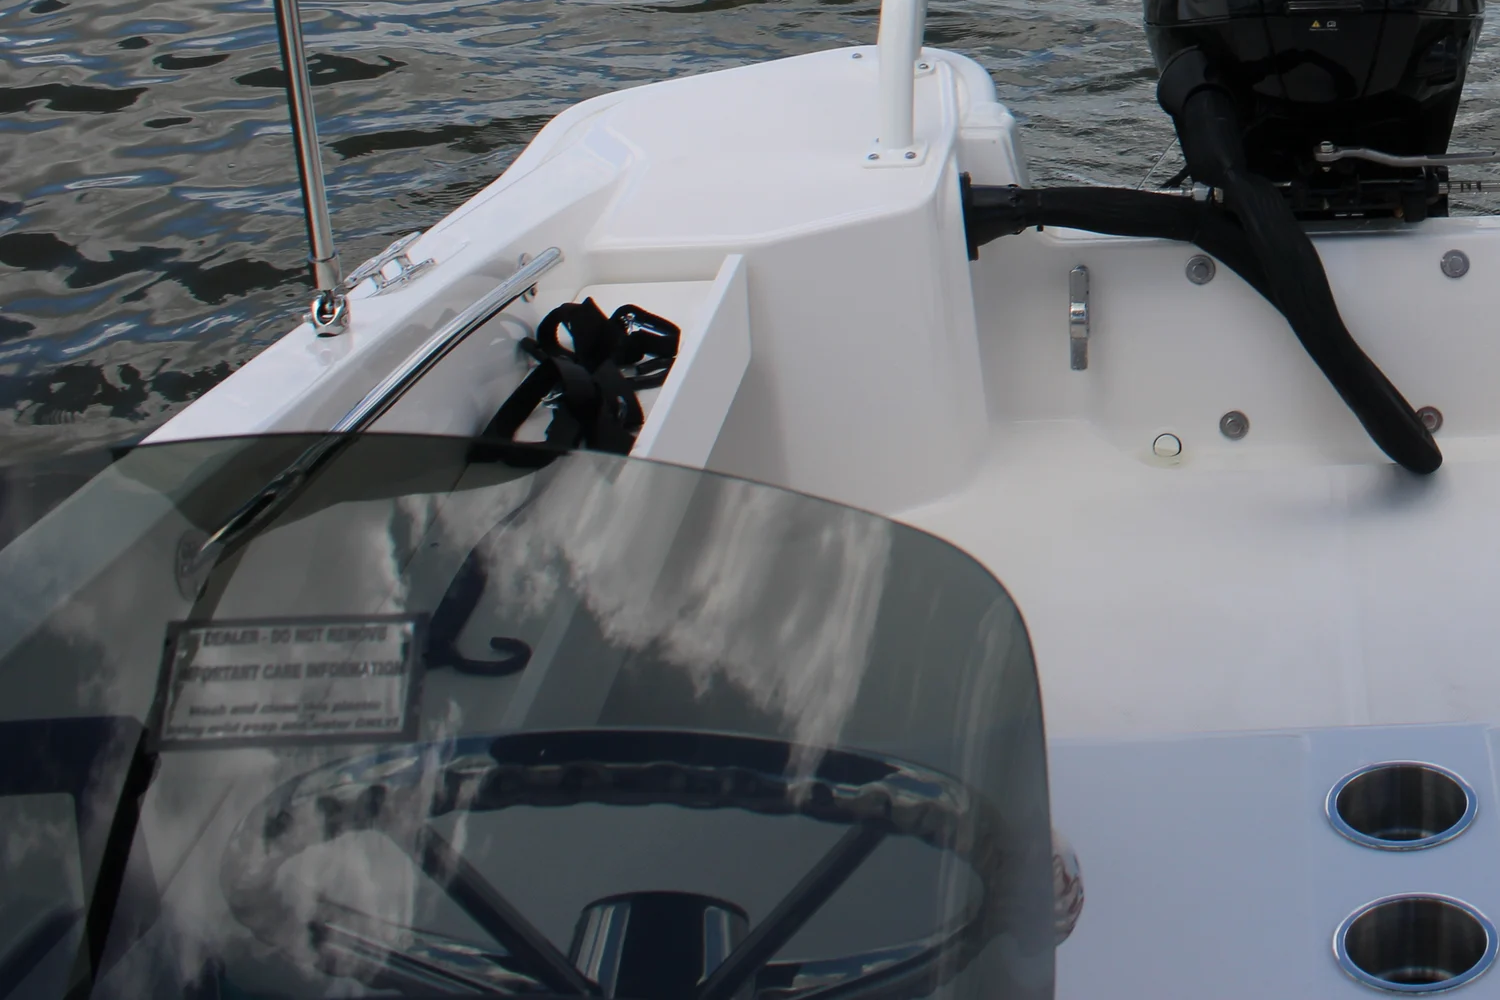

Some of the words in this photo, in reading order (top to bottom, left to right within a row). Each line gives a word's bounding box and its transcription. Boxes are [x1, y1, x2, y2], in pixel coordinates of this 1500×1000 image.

[203, 629, 260, 647] DEALER
[271, 628, 291, 644] DO
[294, 627, 324, 643] NOT
[327, 626, 387, 643] REMOVE
[262, 663, 302, 680] CARE
[306, 661, 406, 679] INFORMATION
